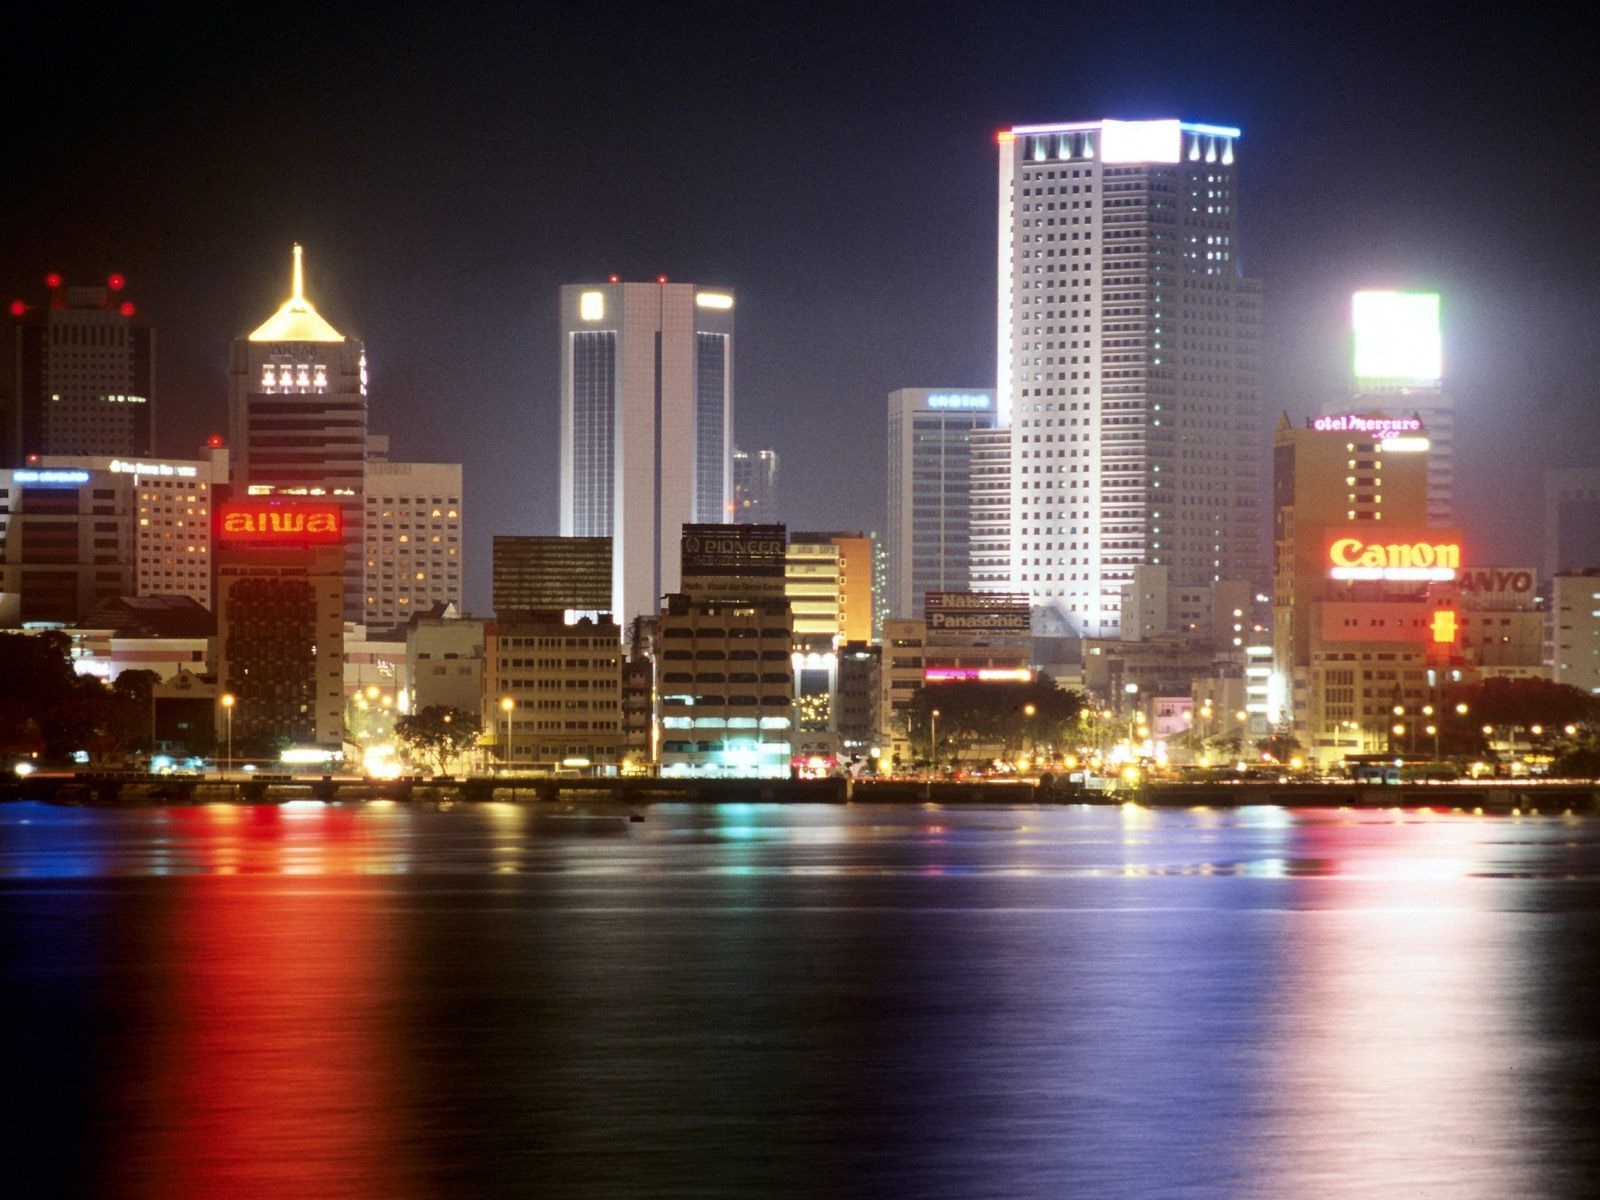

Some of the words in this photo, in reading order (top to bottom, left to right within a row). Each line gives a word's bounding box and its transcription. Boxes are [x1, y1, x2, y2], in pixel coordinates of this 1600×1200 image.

[1306, 416, 1347, 430] otel
[225, 512, 338, 532] aiwa
[705, 540, 781, 554] PIONEER
[1330, 538, 1460, 568] Canon
[1460, 571, 1532, 592] ANYO
[932, 613, 1023, 627] Panasonic
